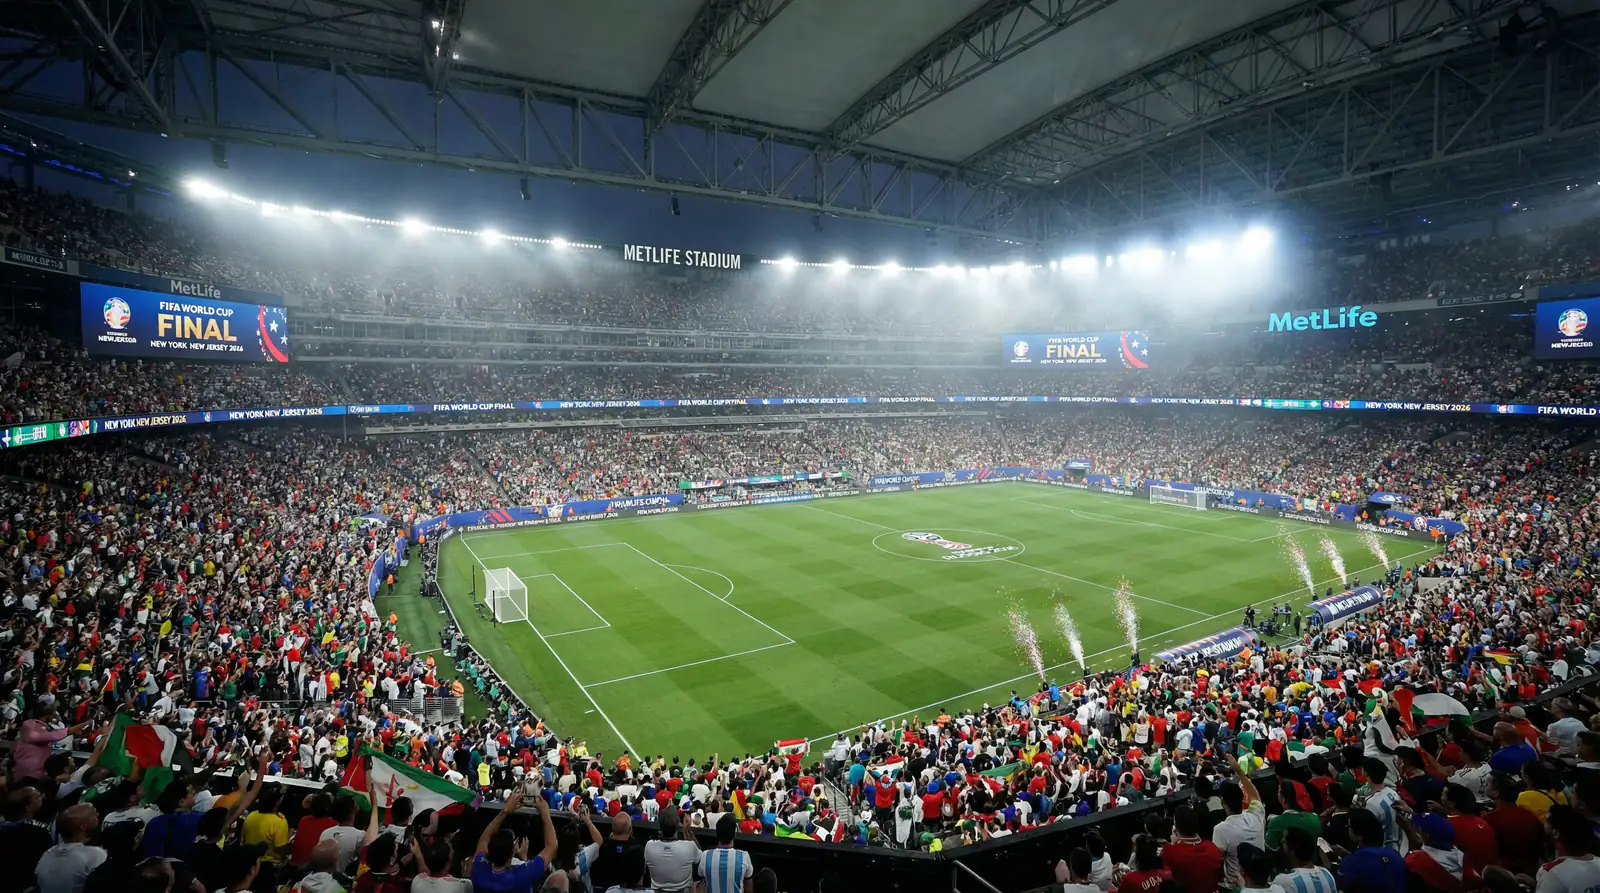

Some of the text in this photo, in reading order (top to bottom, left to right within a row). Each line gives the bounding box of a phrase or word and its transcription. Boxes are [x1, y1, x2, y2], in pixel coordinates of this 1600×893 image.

[624, 244, 741, 270] METLIFE STADIUM
[170, 279, 221, 299] MetLife
[160, 301, 234, 317] FIFA WORLD CUP
[1268, 305, 1378, 332] MetLife
[158, 313, 238, 342] FINAL
[150, 340, 167, 348] NEW
[168, 341, 188, 349] YORK
[189, 342, 205, 350] NEW
[1046, 344, 1101, 358] FINAL
[229, 411, 244, 419] NEW
[245, 410, 264, 419] YORK
[265, 409, 280, 417] NEW
[281, 408, 305, 417] JERSEY
[1404, 402, 1422, 410] NEW
[1422, 403, 1451, 411] JERSEY
[1451, 404, 1471, 412] 2026
[1538, 406, 1597, 416] FIFA WORLD
[104, 420, 118, 430] NEW
[136, 417, 150, 427] NEW
[150, 416, 171, 426] JERSEY
